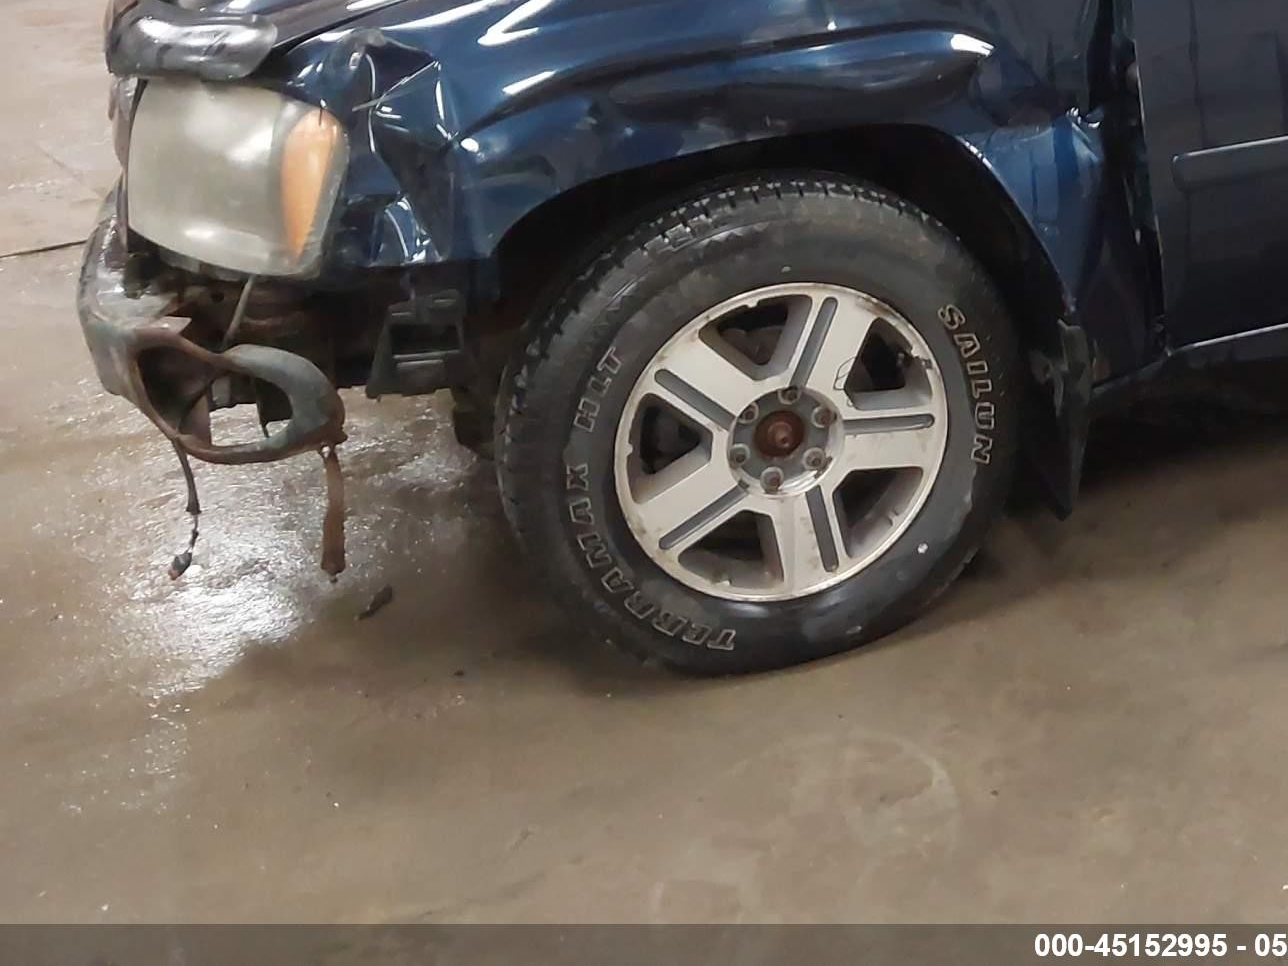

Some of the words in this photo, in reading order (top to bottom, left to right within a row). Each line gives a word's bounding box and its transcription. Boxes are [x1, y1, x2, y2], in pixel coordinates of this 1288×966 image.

[573, 345, 622, 433] HLT
[937, 303, 996, 465] SAILUN
[566, 462, 737, 651] TERRAMAX
